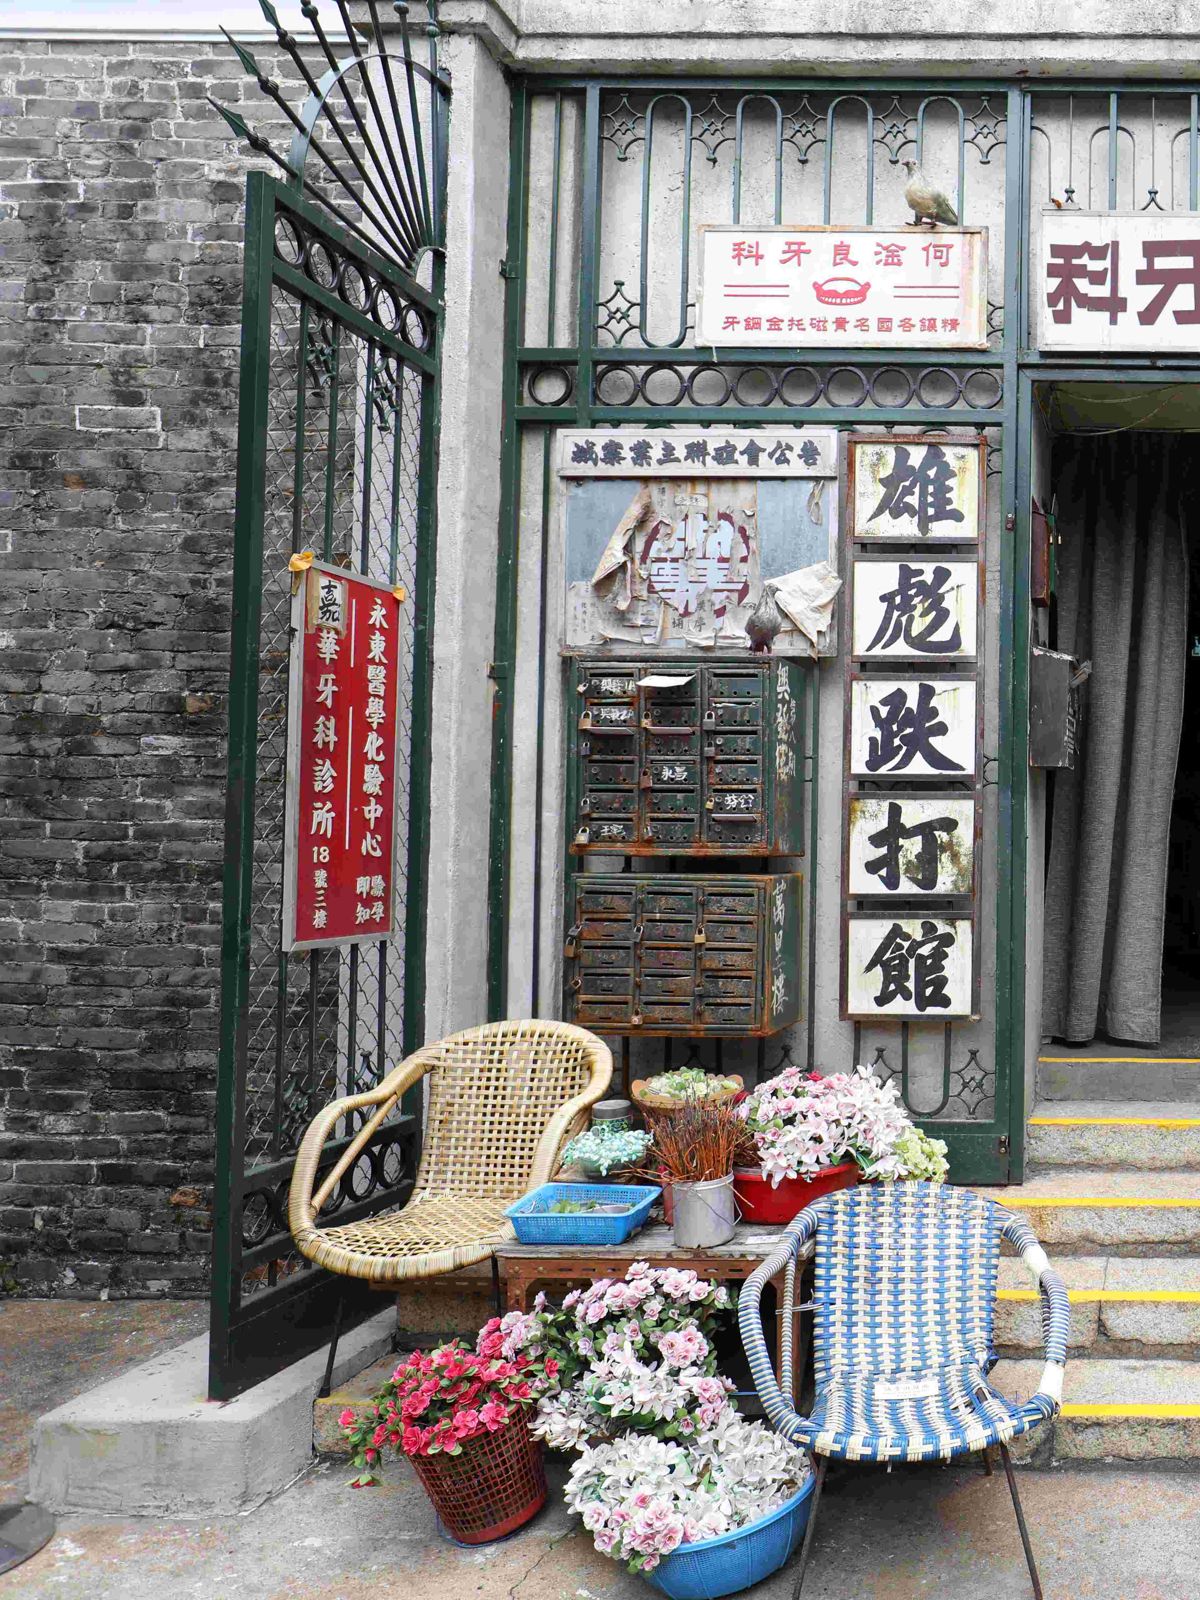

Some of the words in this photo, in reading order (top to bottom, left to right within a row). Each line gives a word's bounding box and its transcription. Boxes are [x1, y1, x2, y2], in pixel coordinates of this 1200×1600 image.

[361, 598, 389, 858] 永東醫學化驗中心
[864, 445, 967, 1013] 雄彪跌打館
